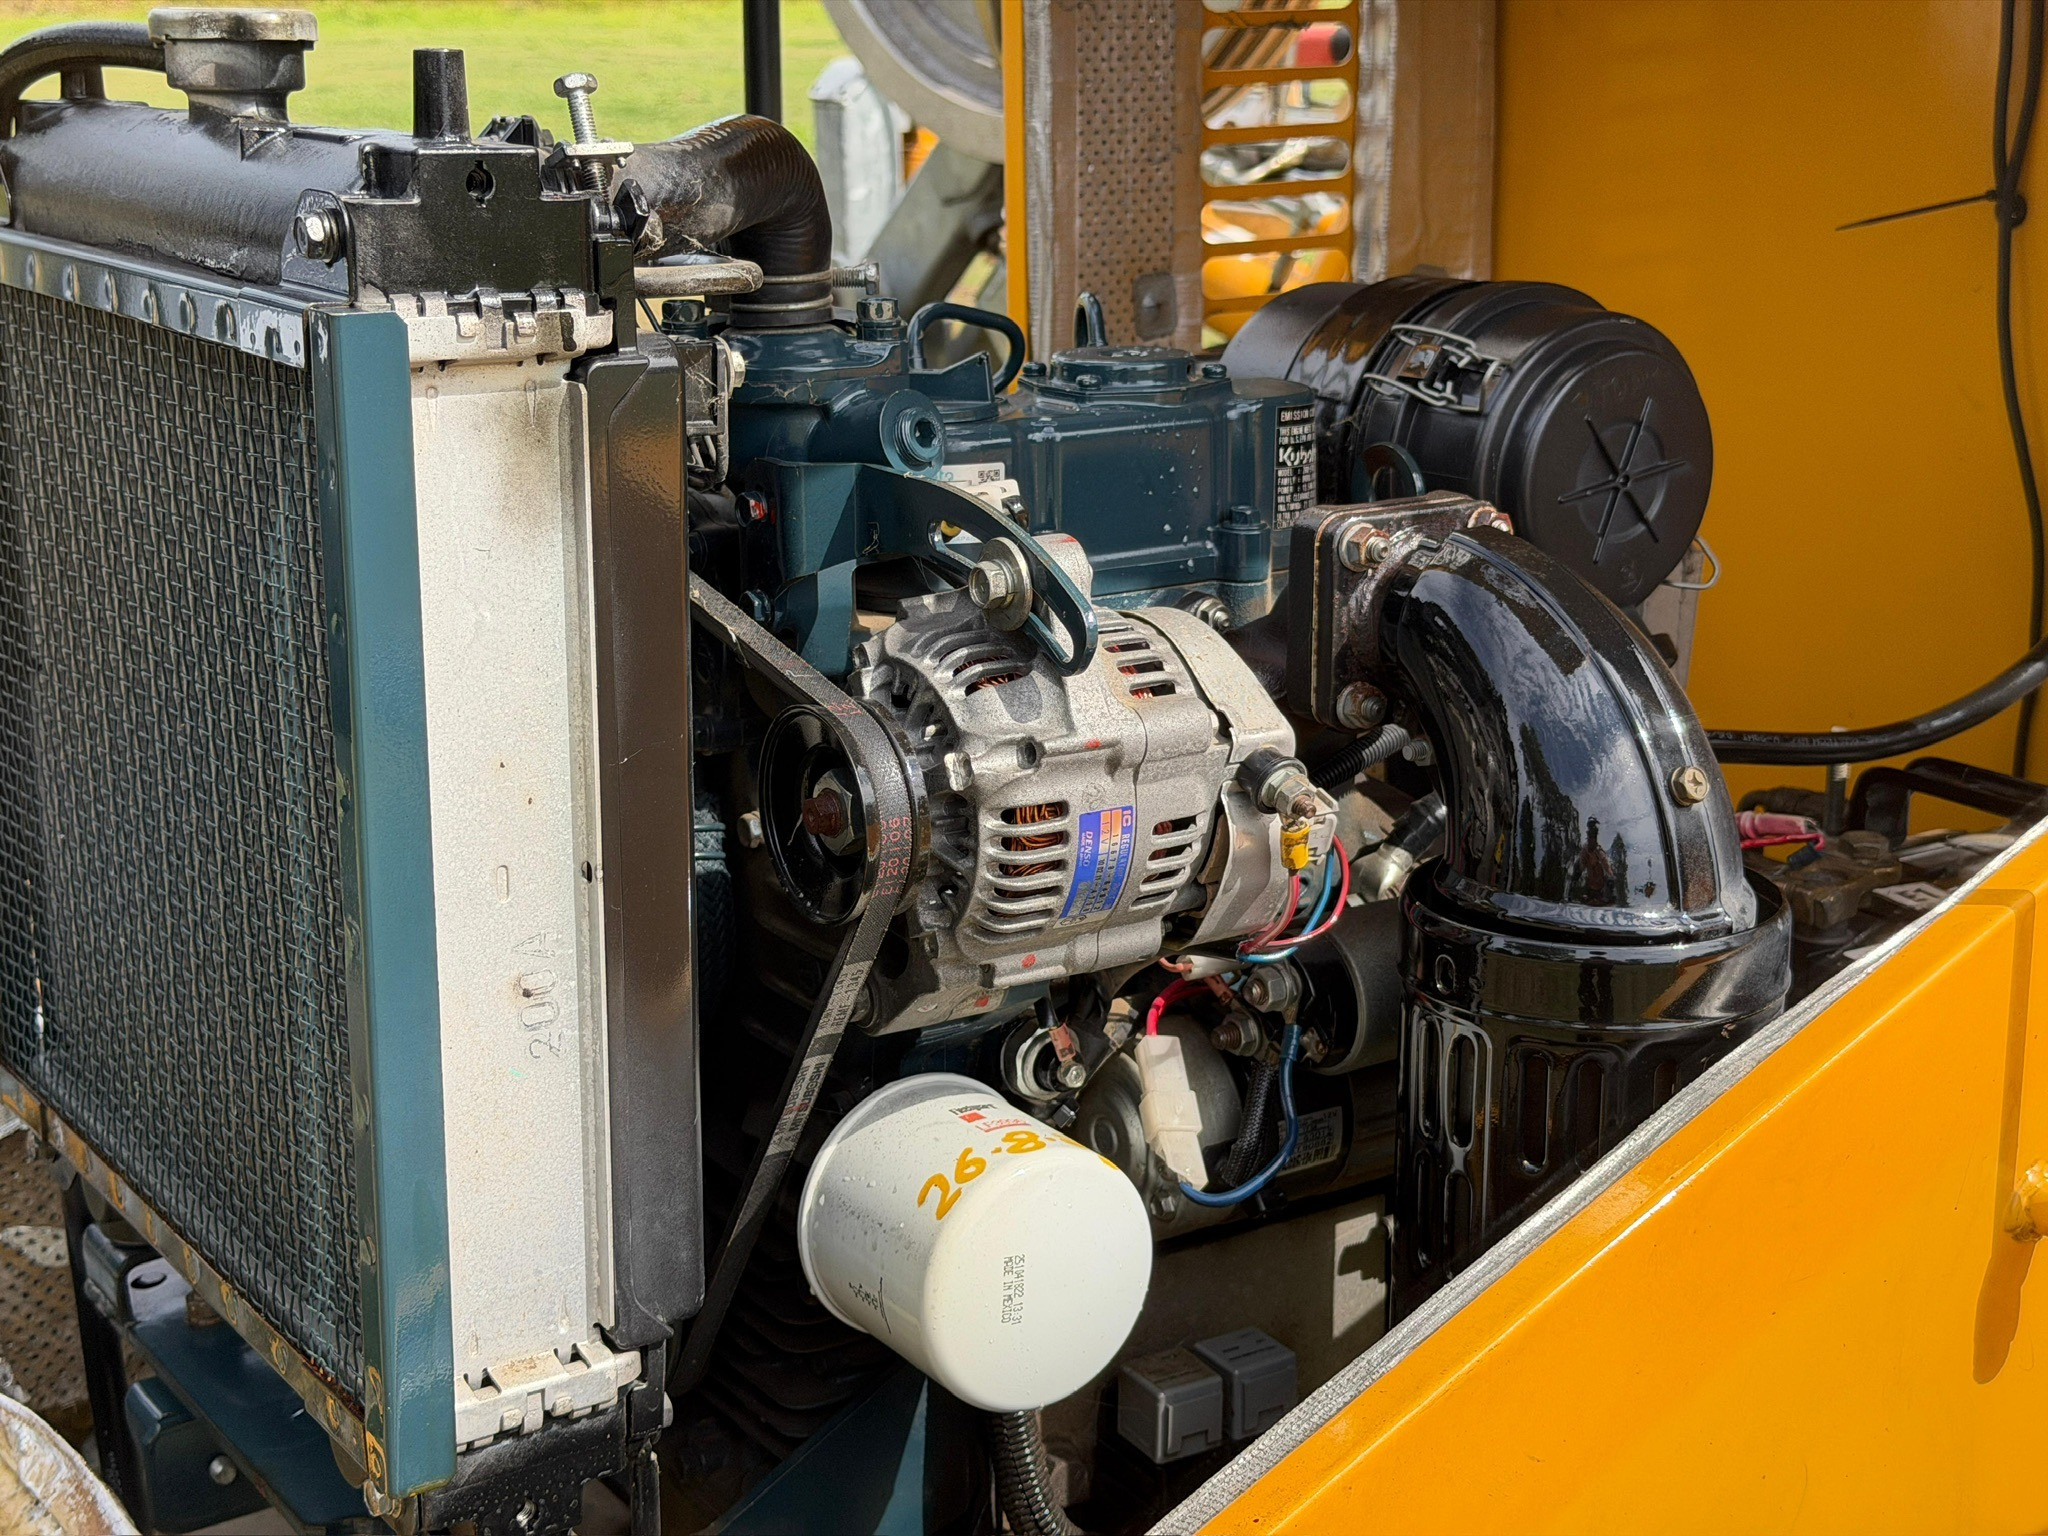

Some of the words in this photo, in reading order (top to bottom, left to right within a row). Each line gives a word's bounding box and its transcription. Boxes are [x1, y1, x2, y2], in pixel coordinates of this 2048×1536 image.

[1083, 830, 1094, 866] DENSO
[789, 1061, 827, 1133] MITSUBOSHI
[1003, 1255, 1014, 1277] MADE
[1003, 1280, 1014, 1292] IN
[1001, 1293, 1014, 1324] MEXICO
[1011, 1301, 1024, 1326] 13:31
